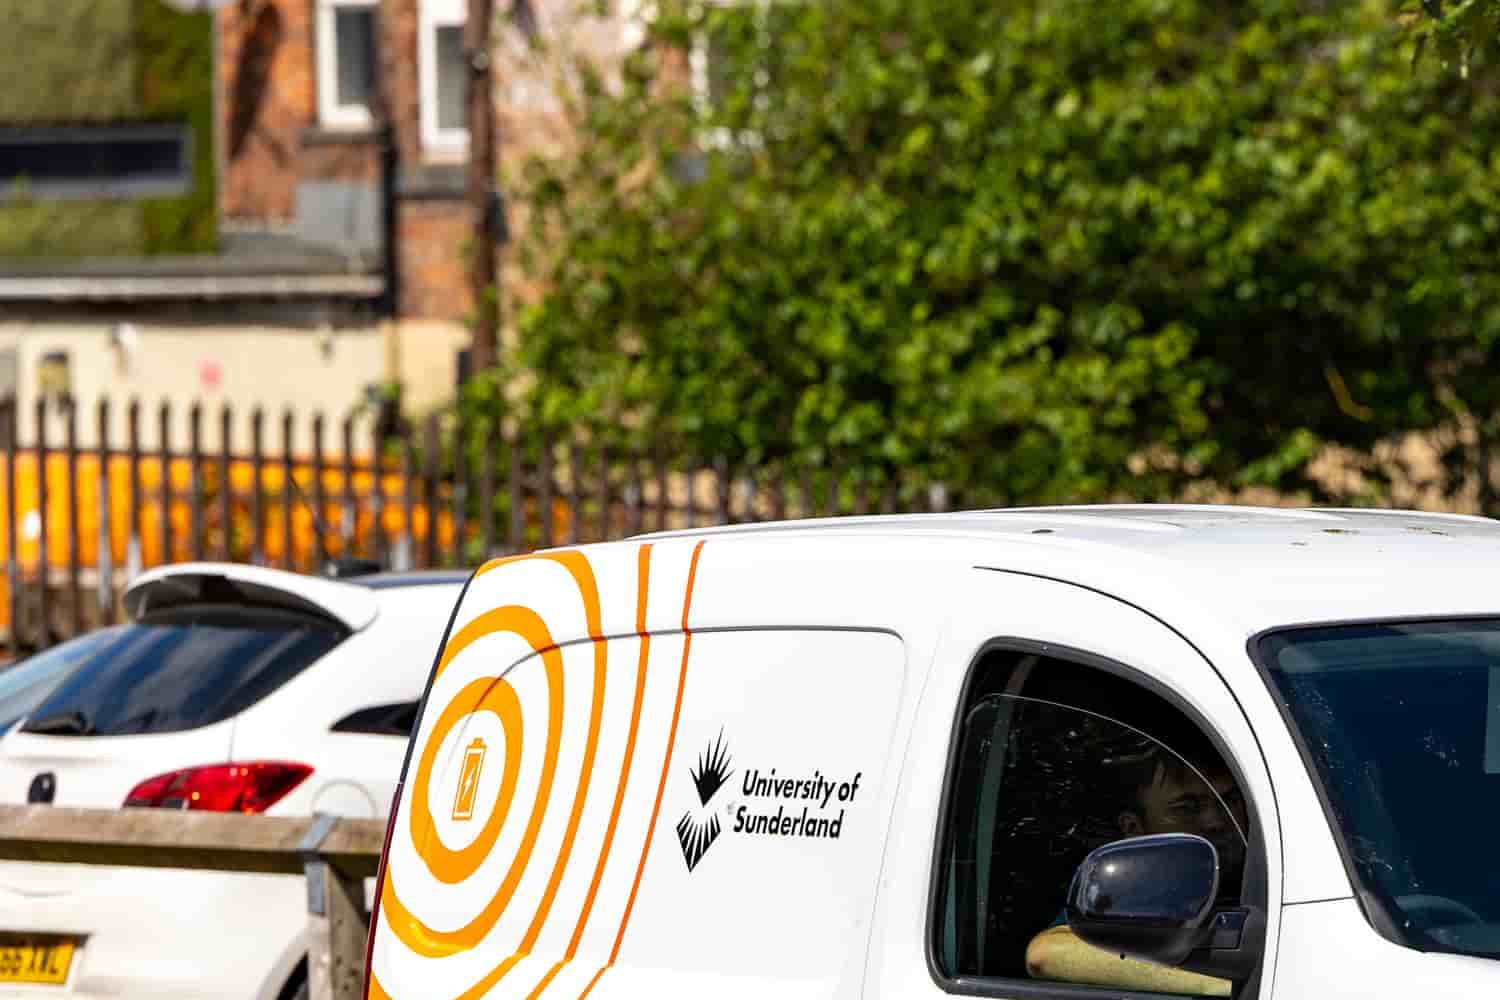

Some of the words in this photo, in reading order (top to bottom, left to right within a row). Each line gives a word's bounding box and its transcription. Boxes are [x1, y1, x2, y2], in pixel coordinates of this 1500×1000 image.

[742, 768, 836, 809] University
[837, 771, 862, 802] of
[733, 805, 845, 840] Sunderland
